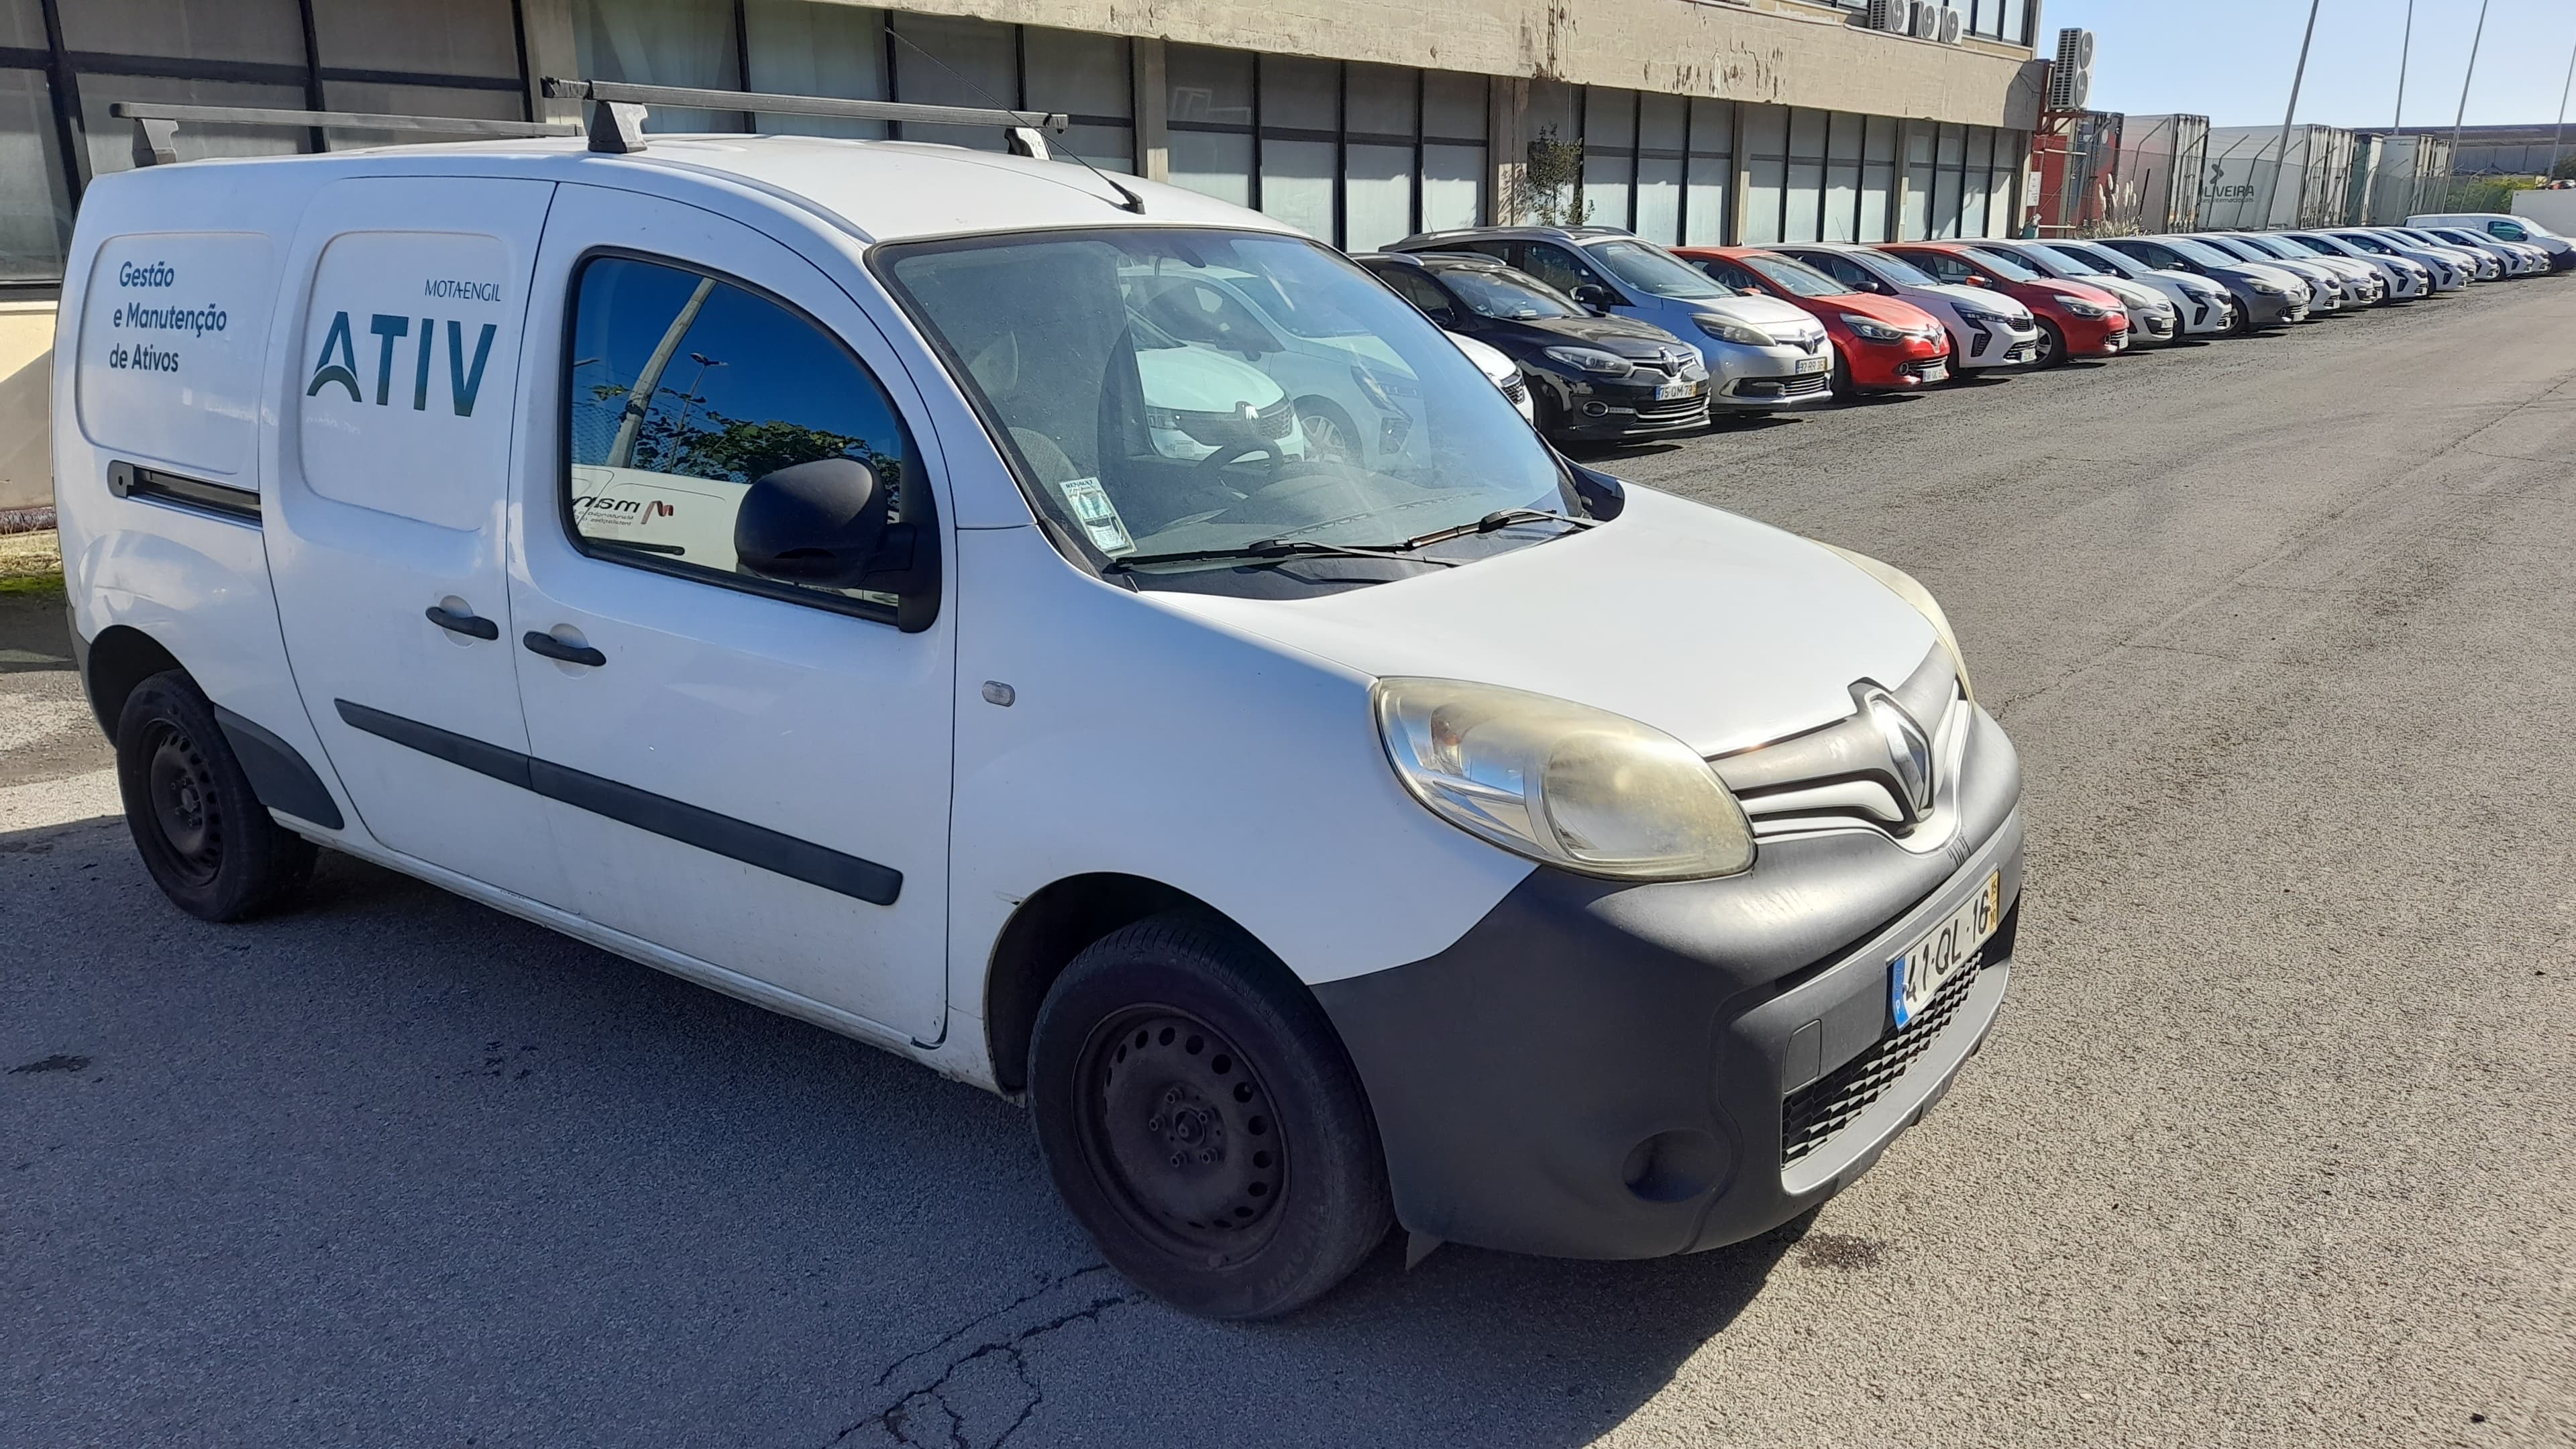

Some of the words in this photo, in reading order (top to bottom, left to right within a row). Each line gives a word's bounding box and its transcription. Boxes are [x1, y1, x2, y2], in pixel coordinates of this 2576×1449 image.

[2201, 186, 2254, 197] LVEIRA
[119, 260, 174, 288] Gestão
[113, 310, 122, 327] e
[126, 303, 227, 337] Manutenção
[109, 345, 127, 369] de
[131, 341, 178, 372] Ativos
[306, 311, 497, 417] ATIV
